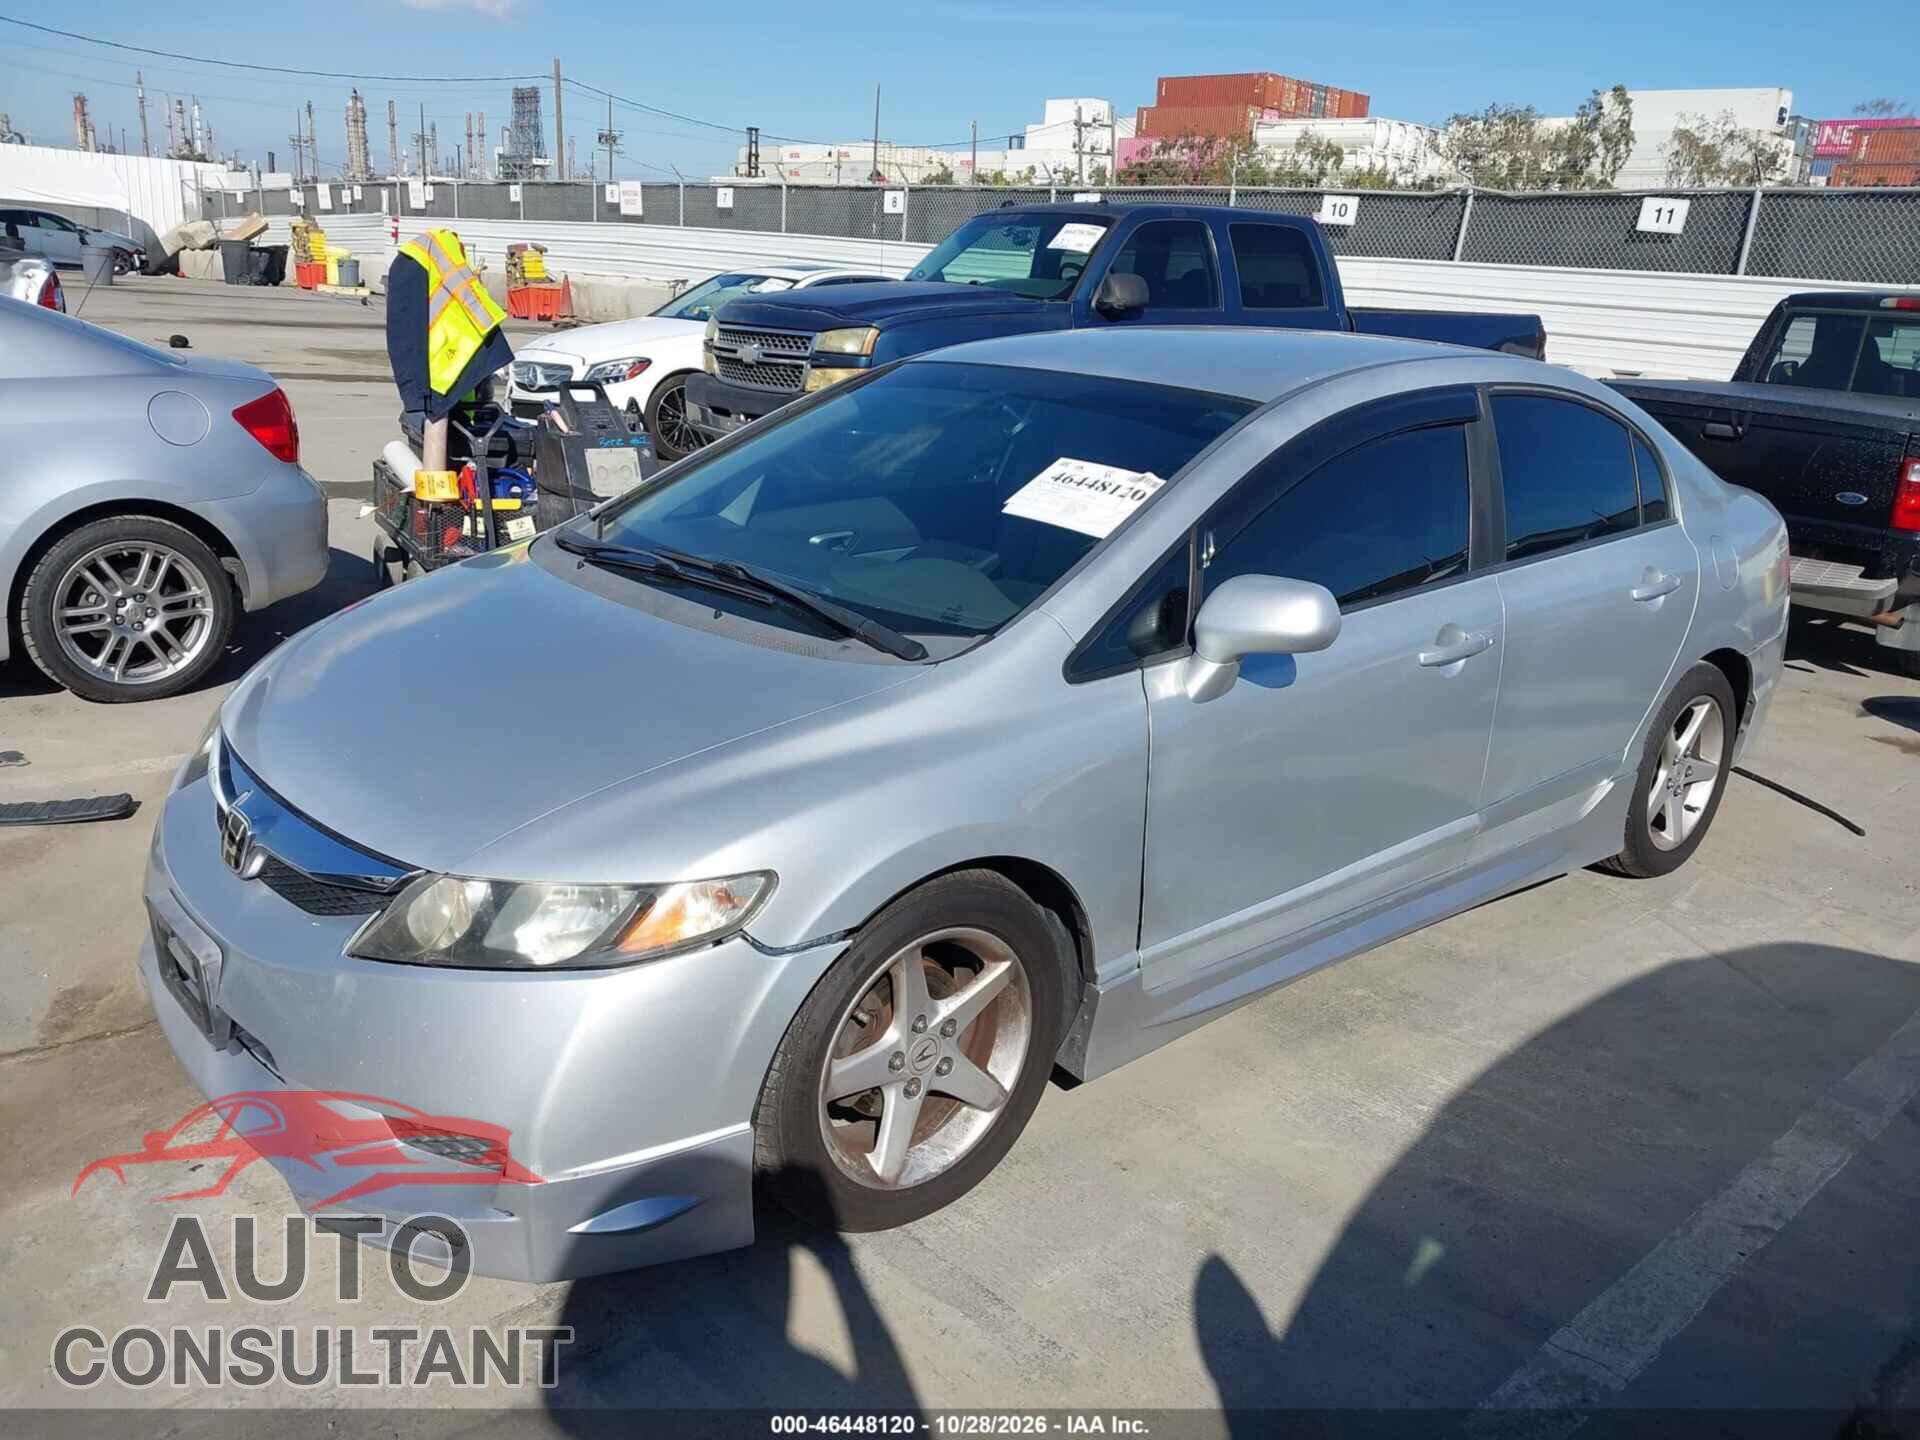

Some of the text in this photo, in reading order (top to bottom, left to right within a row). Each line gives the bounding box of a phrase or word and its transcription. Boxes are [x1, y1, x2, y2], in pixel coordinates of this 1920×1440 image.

[722, 192, 728, 203] 7
[891, 196, 897, 208] 8
[1332, 203, 1348, 217] 10
[1655, 207, 1674, 224] 11
[1051, 472, 1147, 501] 46448120
